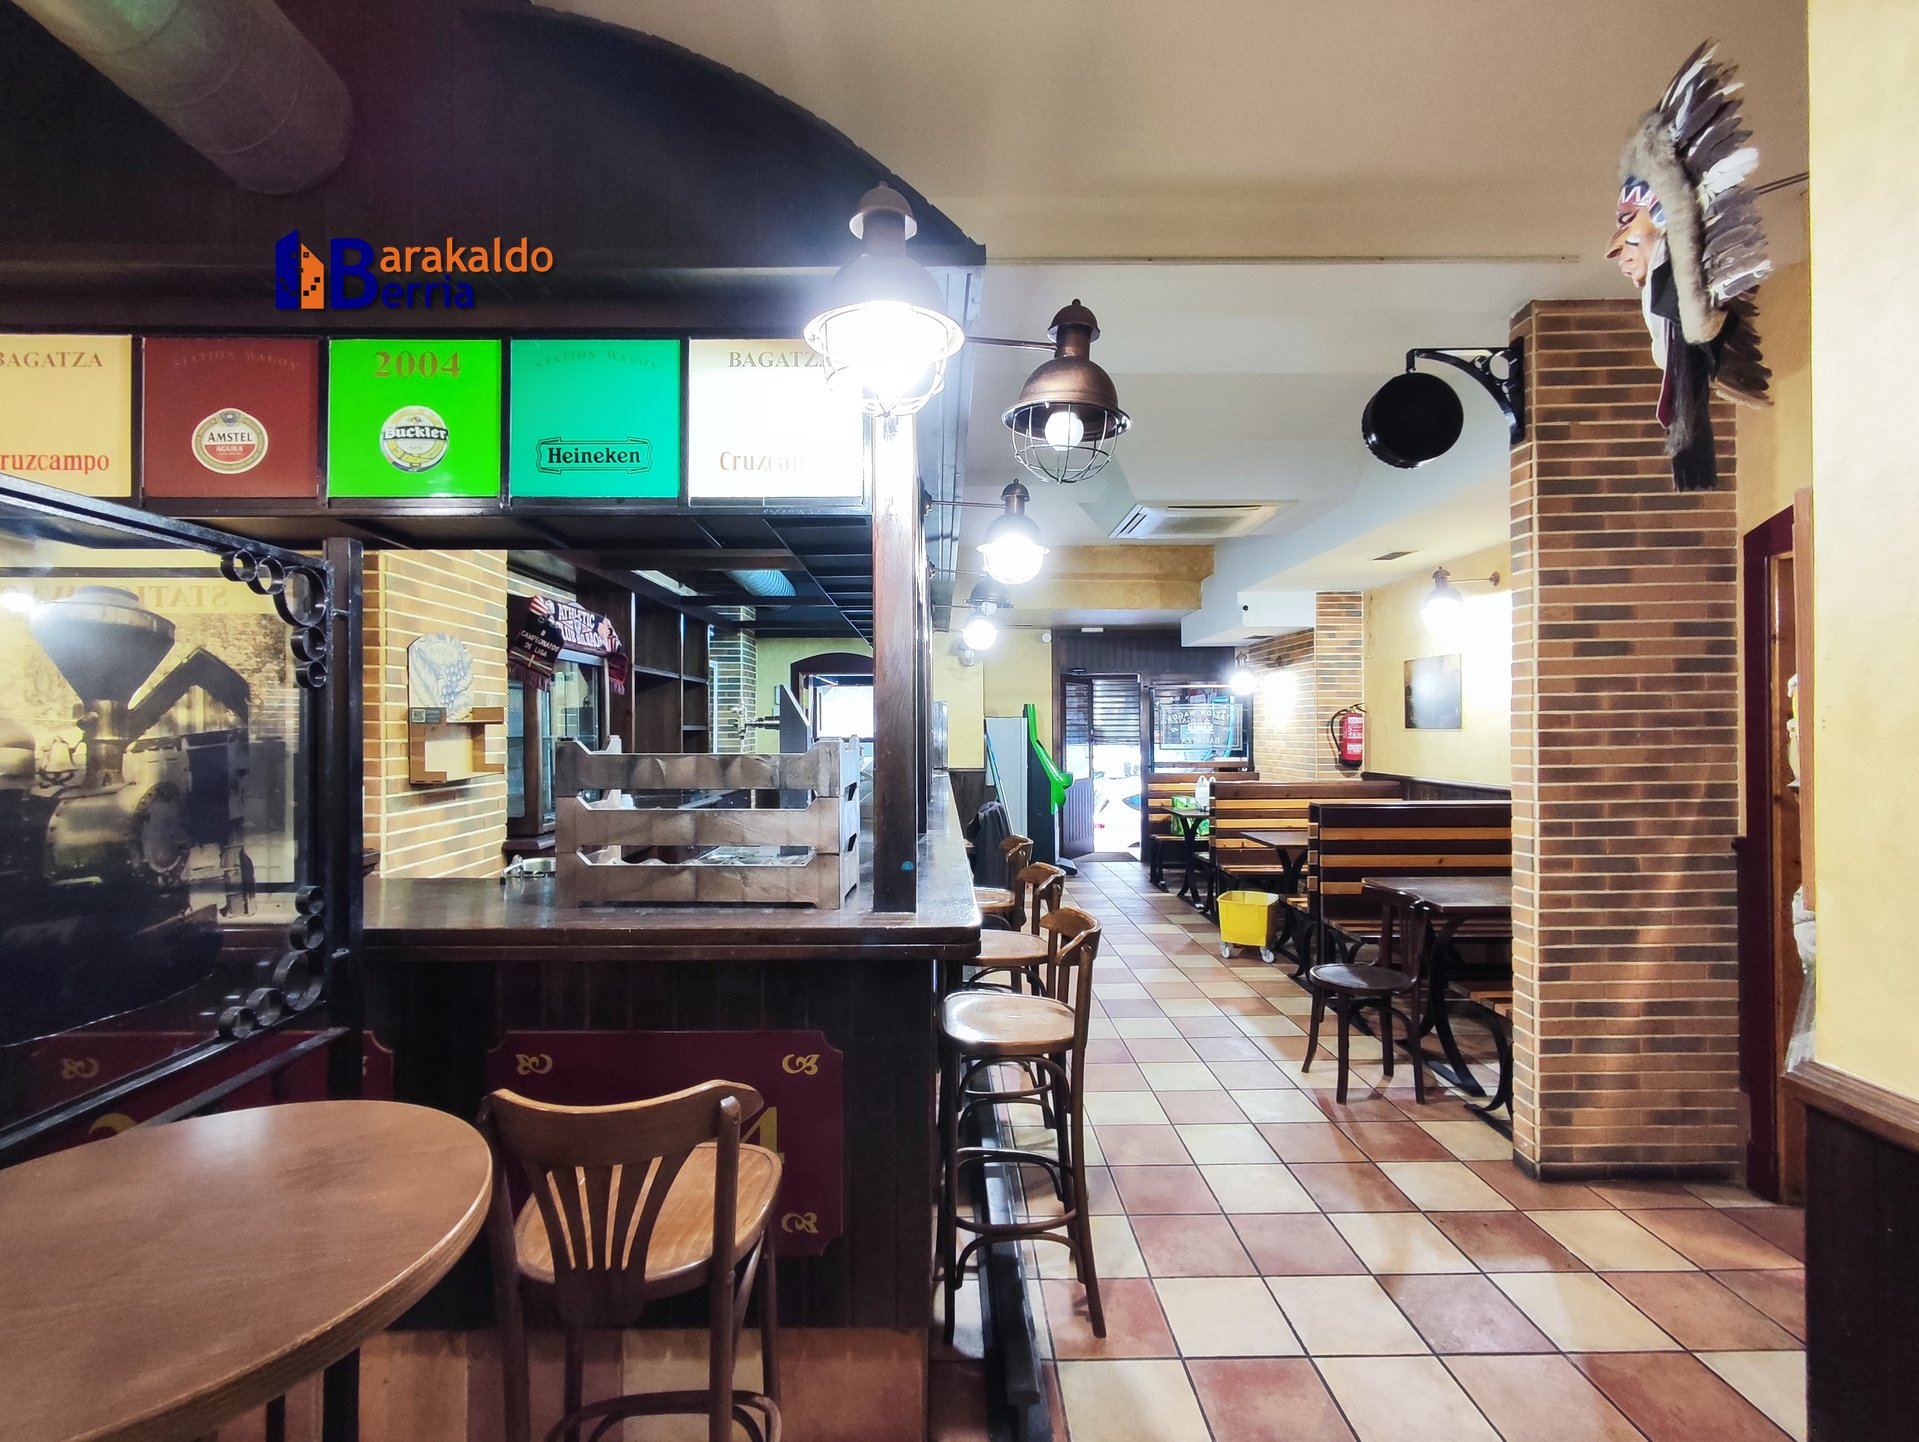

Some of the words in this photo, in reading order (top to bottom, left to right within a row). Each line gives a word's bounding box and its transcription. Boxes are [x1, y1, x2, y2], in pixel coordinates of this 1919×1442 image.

[374, 351, 461, 378] 2004
[208, 431, 253, 442] AMSTEL
[384, 425, 447, 440] Buckler
[547, 447, 641, 464] Heineken
[557, 602, 595, 630] ATHLETIC
